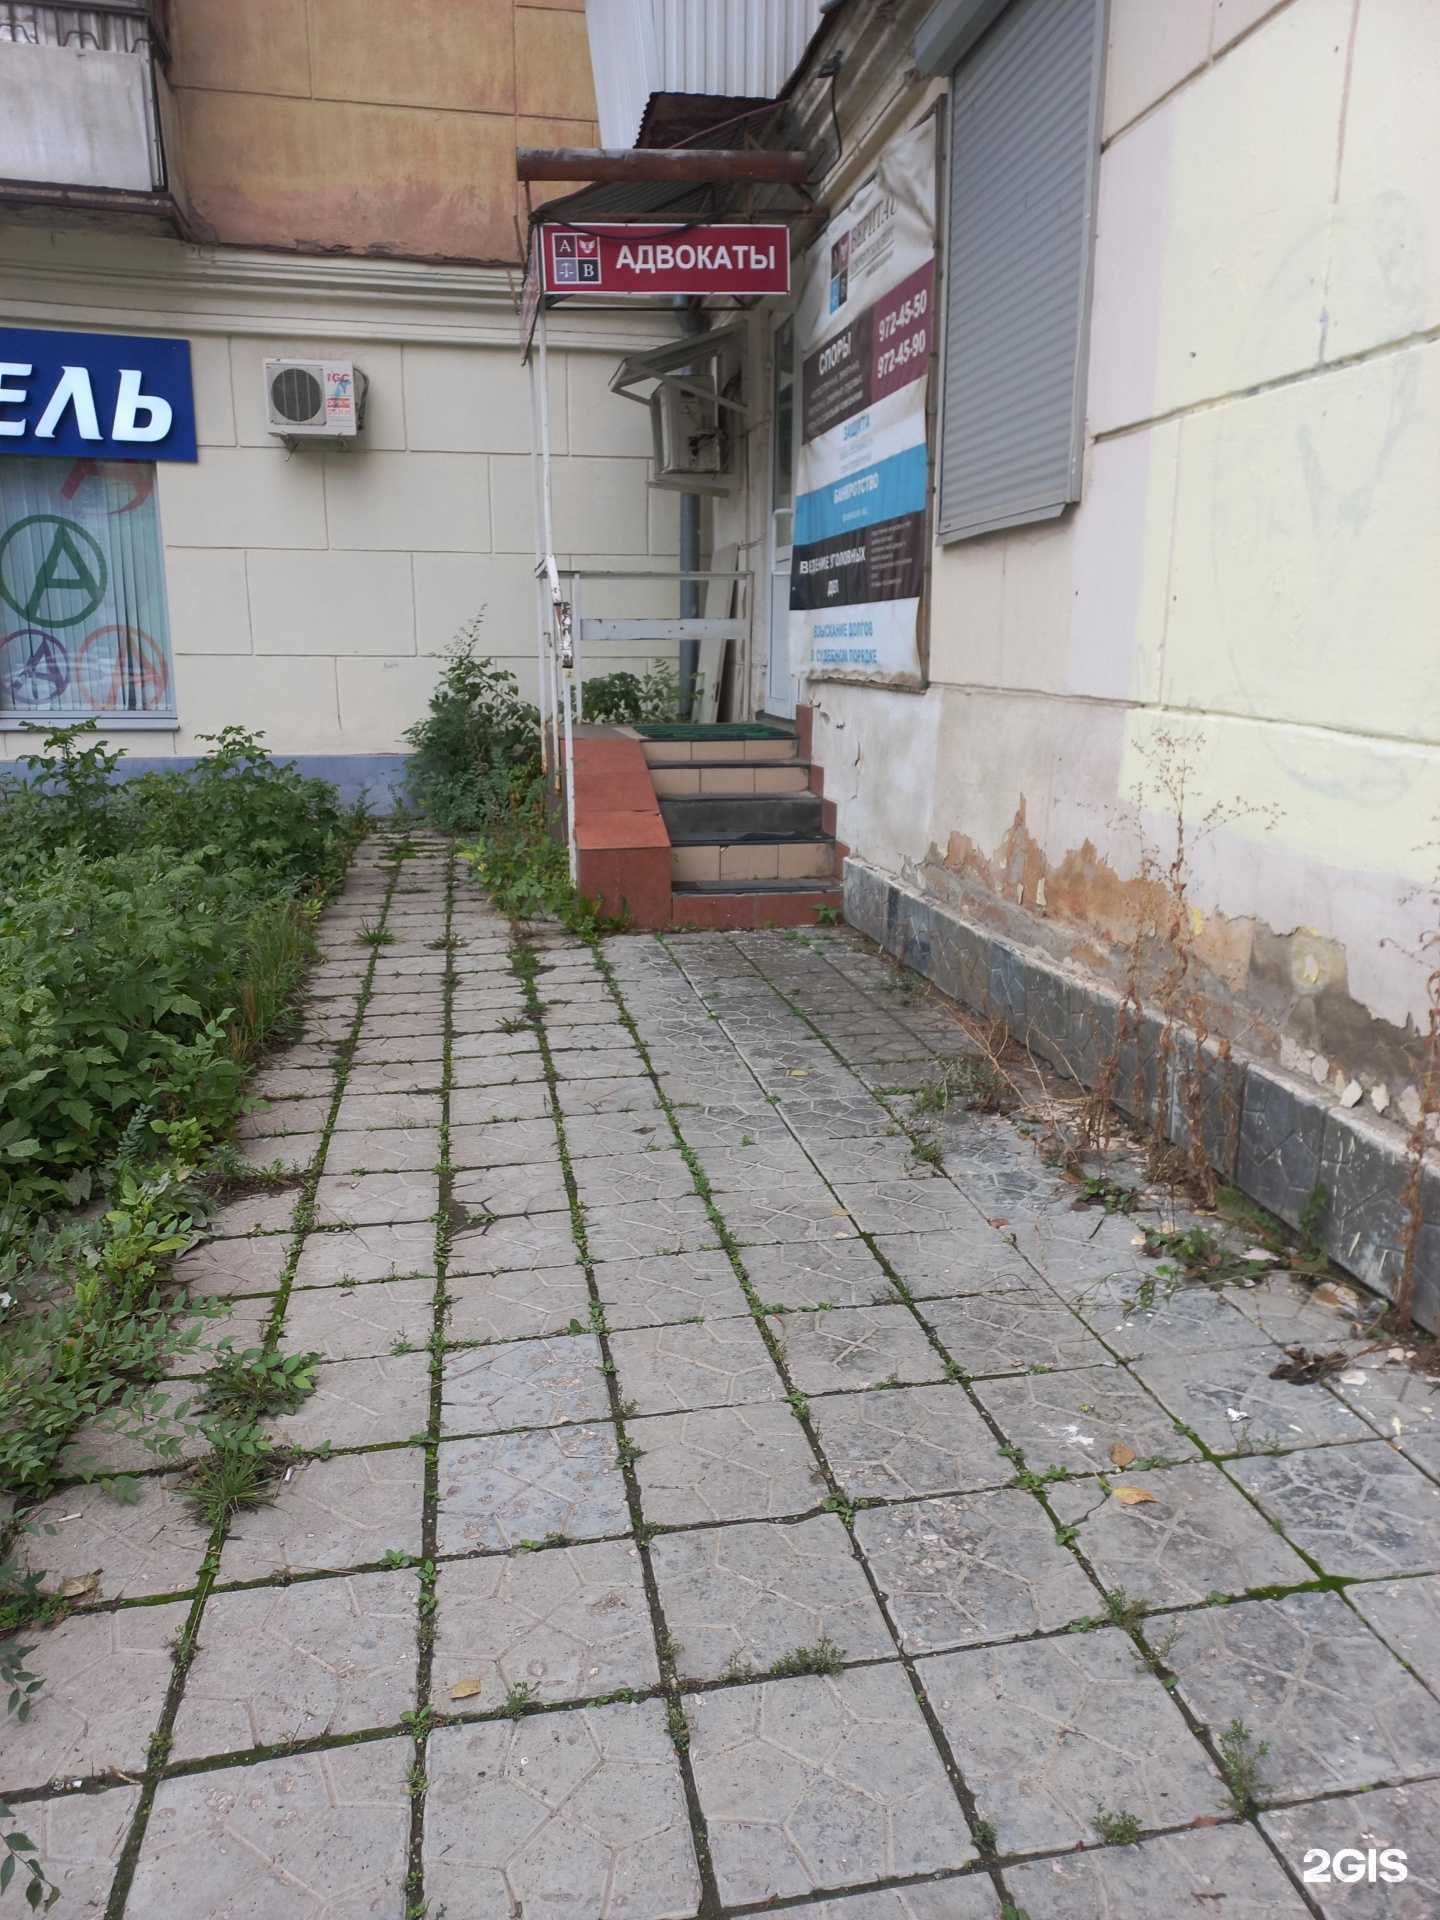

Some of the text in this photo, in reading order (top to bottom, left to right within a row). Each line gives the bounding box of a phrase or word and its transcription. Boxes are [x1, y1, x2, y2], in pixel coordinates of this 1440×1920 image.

[616, 245, 775, 274] АДВОКАТЫ
[879, 289, 927, 342] 972-45-50
[819, 332, 851, 376] СПОРЫ
[877, 329, 926, 379] 972-45-90
[833, 472, 879, 505] БАНКРОТСТВО
[800, 546, 866, 575] ВЕДЕНИЕ УГОЛОВНЫХ
[813, 621, 873, 639] ВЗЫСКАНИЕ ДОЛГОВ
[816, 649, 848, 664] СУДЕБНОМ
[849, 649, 877, 664] ПОРЯДКЕ
